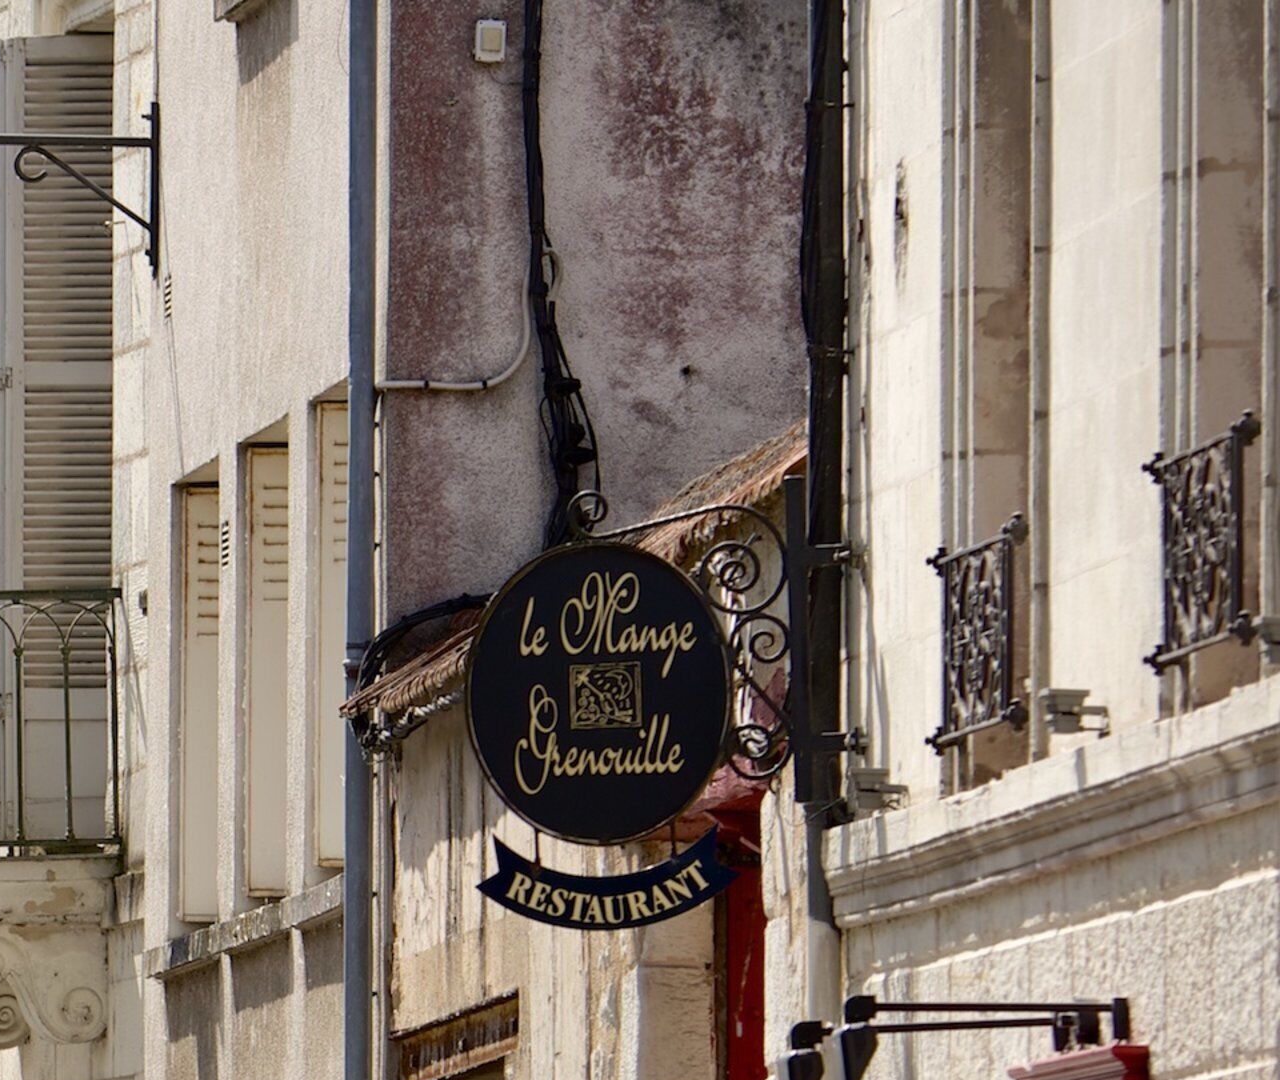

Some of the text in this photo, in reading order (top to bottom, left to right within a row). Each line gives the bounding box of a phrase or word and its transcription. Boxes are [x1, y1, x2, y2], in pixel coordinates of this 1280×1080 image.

[520, 571, 697, 679] le Mange
[514, 684, 685, 795] Grenouille
[506, 859, 710, 924] RESTAURANT
